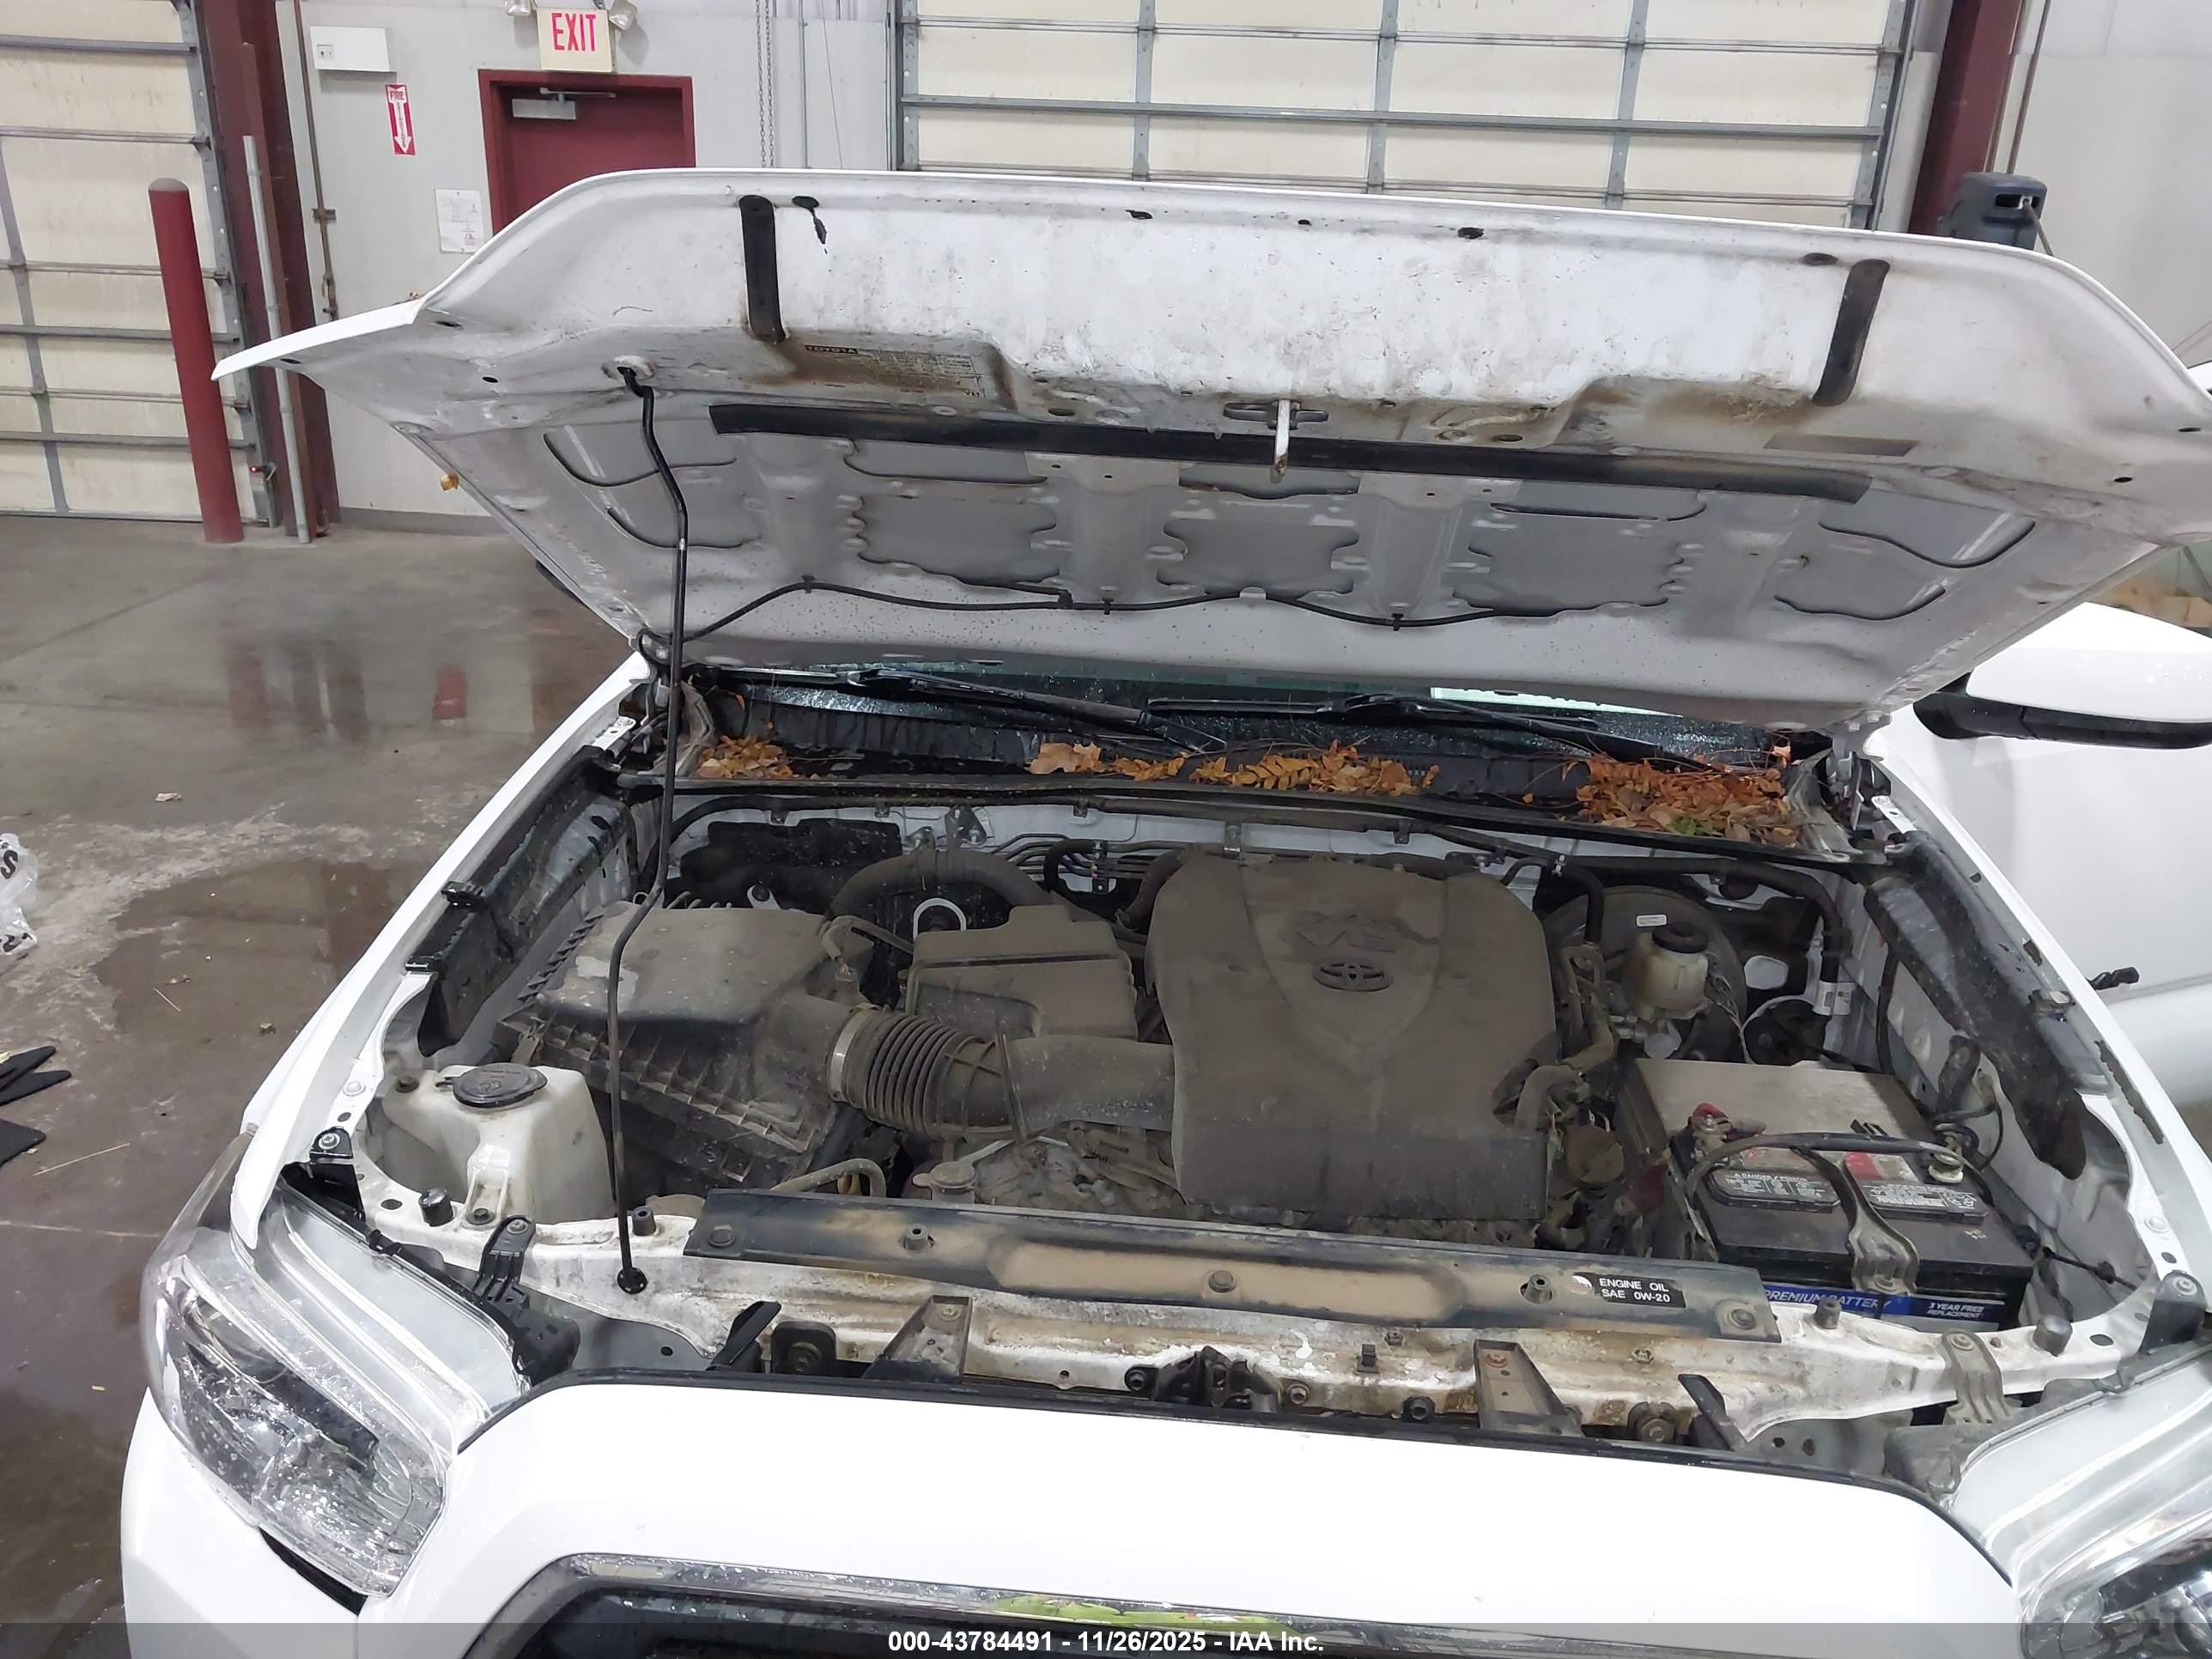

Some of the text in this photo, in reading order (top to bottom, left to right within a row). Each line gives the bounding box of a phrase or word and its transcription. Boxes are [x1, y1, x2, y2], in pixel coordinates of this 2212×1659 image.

[551, 13, 597, 52] EXIT
[390, 91, 405, 100] FIRE
[1599, 1278, 1669, 1292] ENGINE OIL
[1601, 1289, 1671, 1303] SAE 0W-20
[1765, 1290, 1826, 1304] PREMIUM
[1937, 1303, 1960, 1311] YEAR
[1960, 1304, 1985, 1313] FREE
